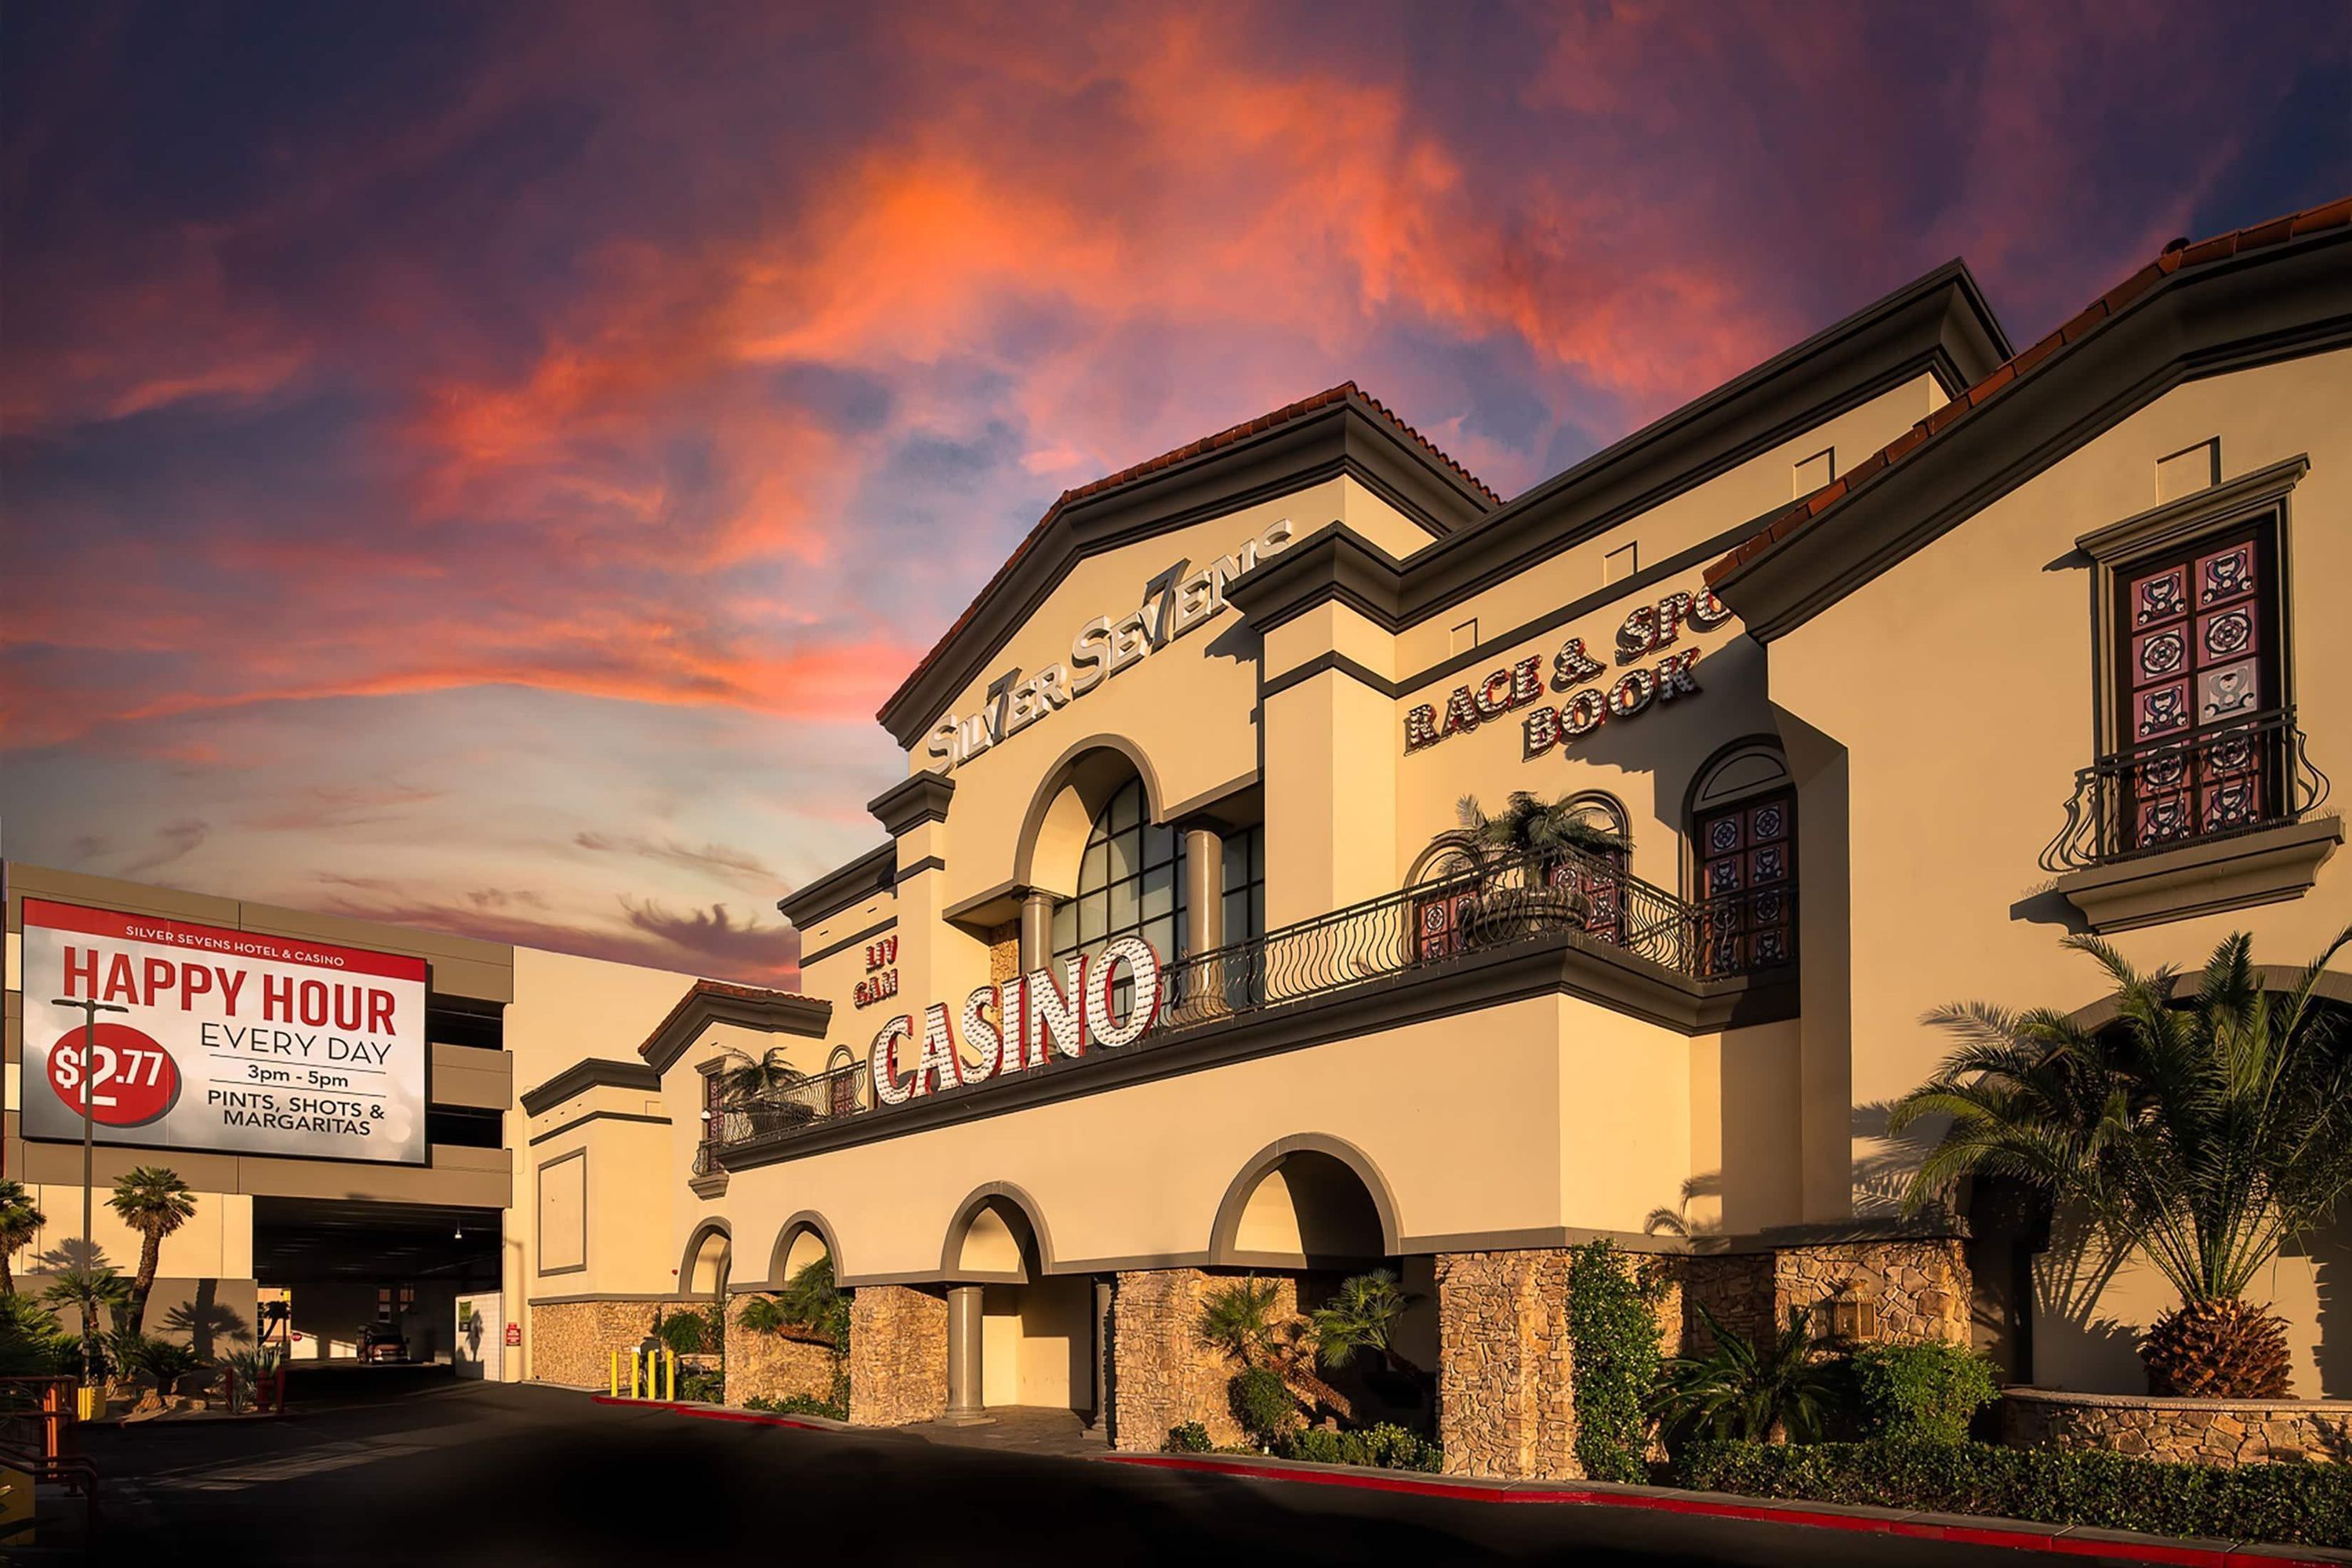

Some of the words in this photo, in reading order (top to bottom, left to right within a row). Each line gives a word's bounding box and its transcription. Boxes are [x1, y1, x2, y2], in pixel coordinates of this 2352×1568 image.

[927, 662, 1070, 776] SILVER
[1406, 653, 1544, 750] RACE
[1555, 637, 1607, 686] &
[1527, 646, 1702, 756] BOOK
[125, 925, 173, 942] SILVER
[178, 933, 230, 950] SEVENS
[234, 942, 278, 958] HOTEL
[282, 949, 292, 959] &
[295, 951, 344, 967] CASINO
[64, 946, 247, 1017] HAPPY
[263, 974, 396, 1036] HOUR
[873, 935, 1163, 1105] CASINO
[201, 1022, 317, 1057] EVERY
[328, 1036, 392, 1065] DAY
[55, 1044, 164, 1107] $2.77
[208, 1090, 281, 1113] PINTS,
[289, 1097, 362, 1118] SHOTS
[369, 1105, 385, 1120] &
[248, 1065, 290, 1083] 3pm
[308, 1071, 348, 1089] 5pm
[223, 1110, 371, 1136] MARGARITAS
